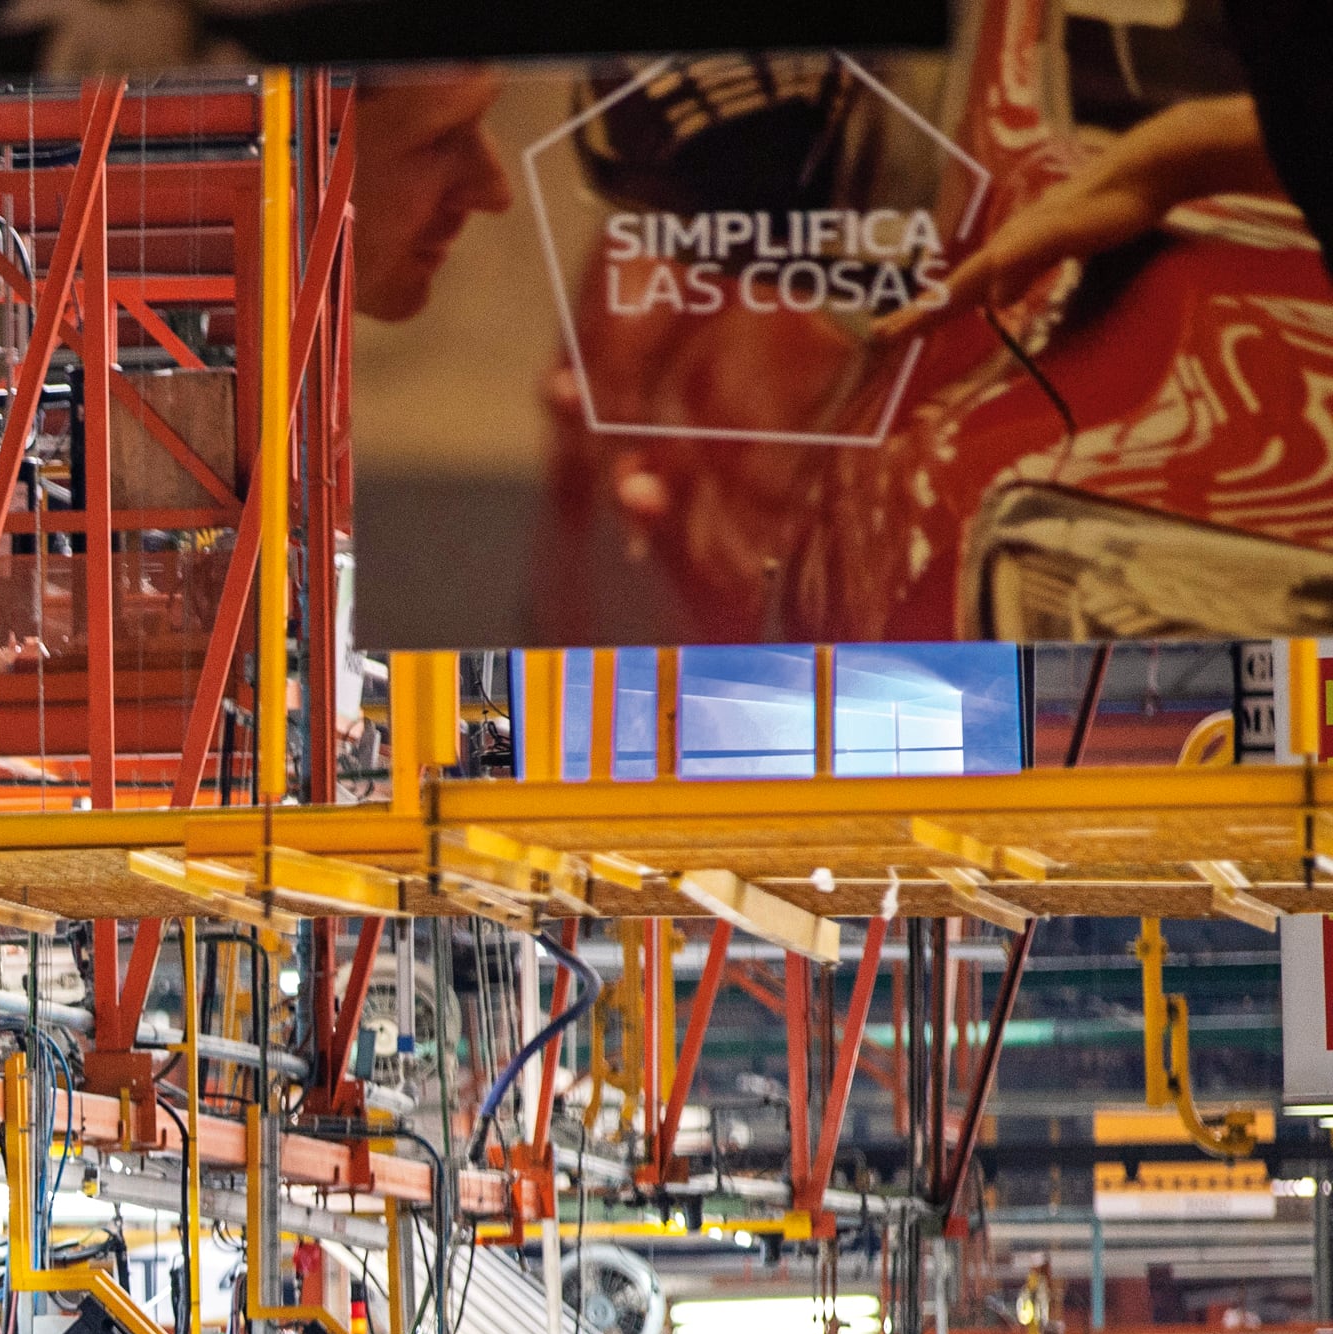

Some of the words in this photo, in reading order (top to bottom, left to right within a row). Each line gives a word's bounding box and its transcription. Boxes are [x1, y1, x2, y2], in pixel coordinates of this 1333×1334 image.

[607, 210, 943, 260] SIMPLIFICA
[607, 263, 725, 316] LAS
[739, 258, 951, 313] COSAS
